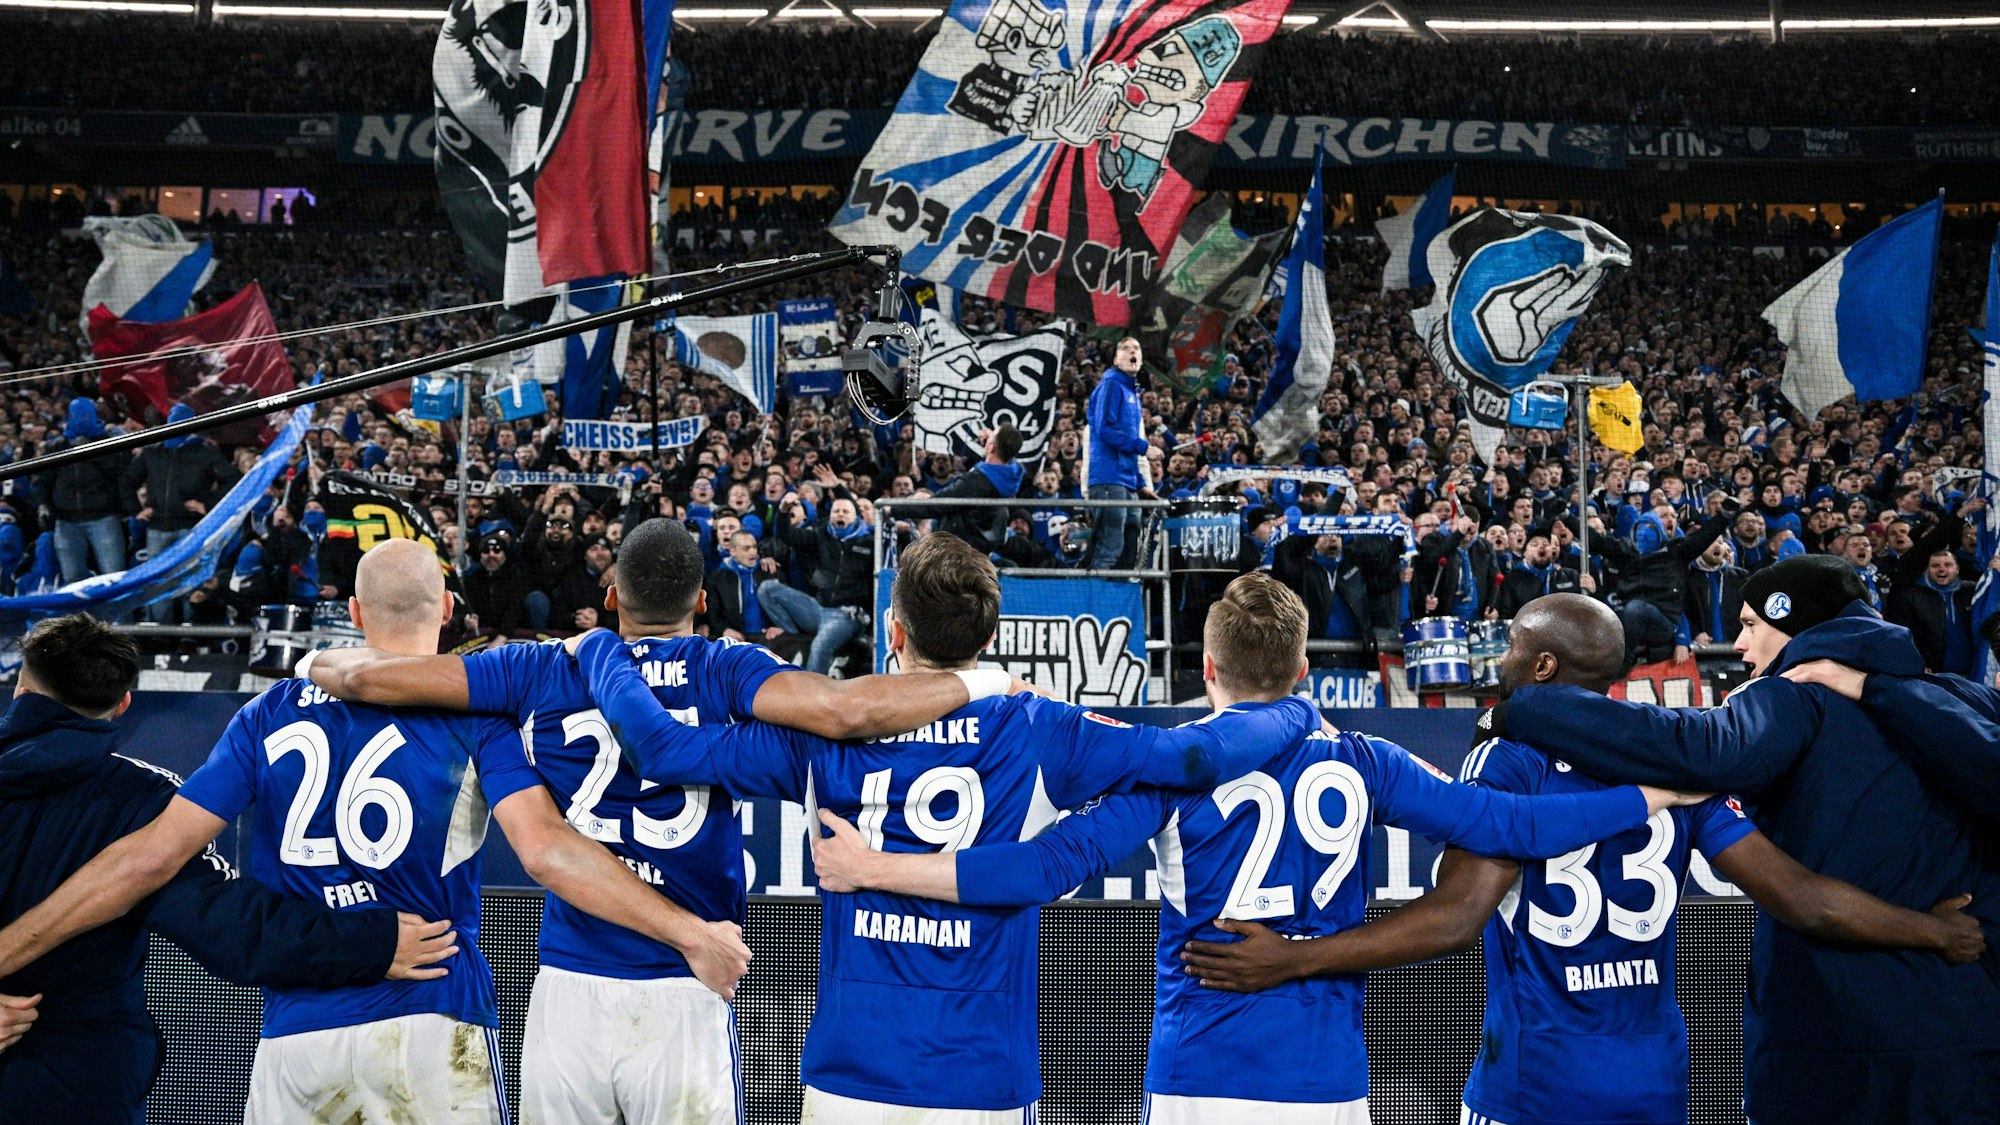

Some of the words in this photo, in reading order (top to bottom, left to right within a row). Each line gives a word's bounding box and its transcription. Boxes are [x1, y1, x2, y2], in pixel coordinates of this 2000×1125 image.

[1003, 353, 1045, 406] S
[632, 644, 650, 659] S04
[263, 720, 414, 870] 26
[857, 766, 985, 854] 19
[1212, 760, 1369, 921] 29
[324, 881, 379, 910] FREY
[1528, 807, 1679, 948] 33
[853, 909, 971, 948] KARAMAN
[1563, 959, 1660, 992] BALANTA
